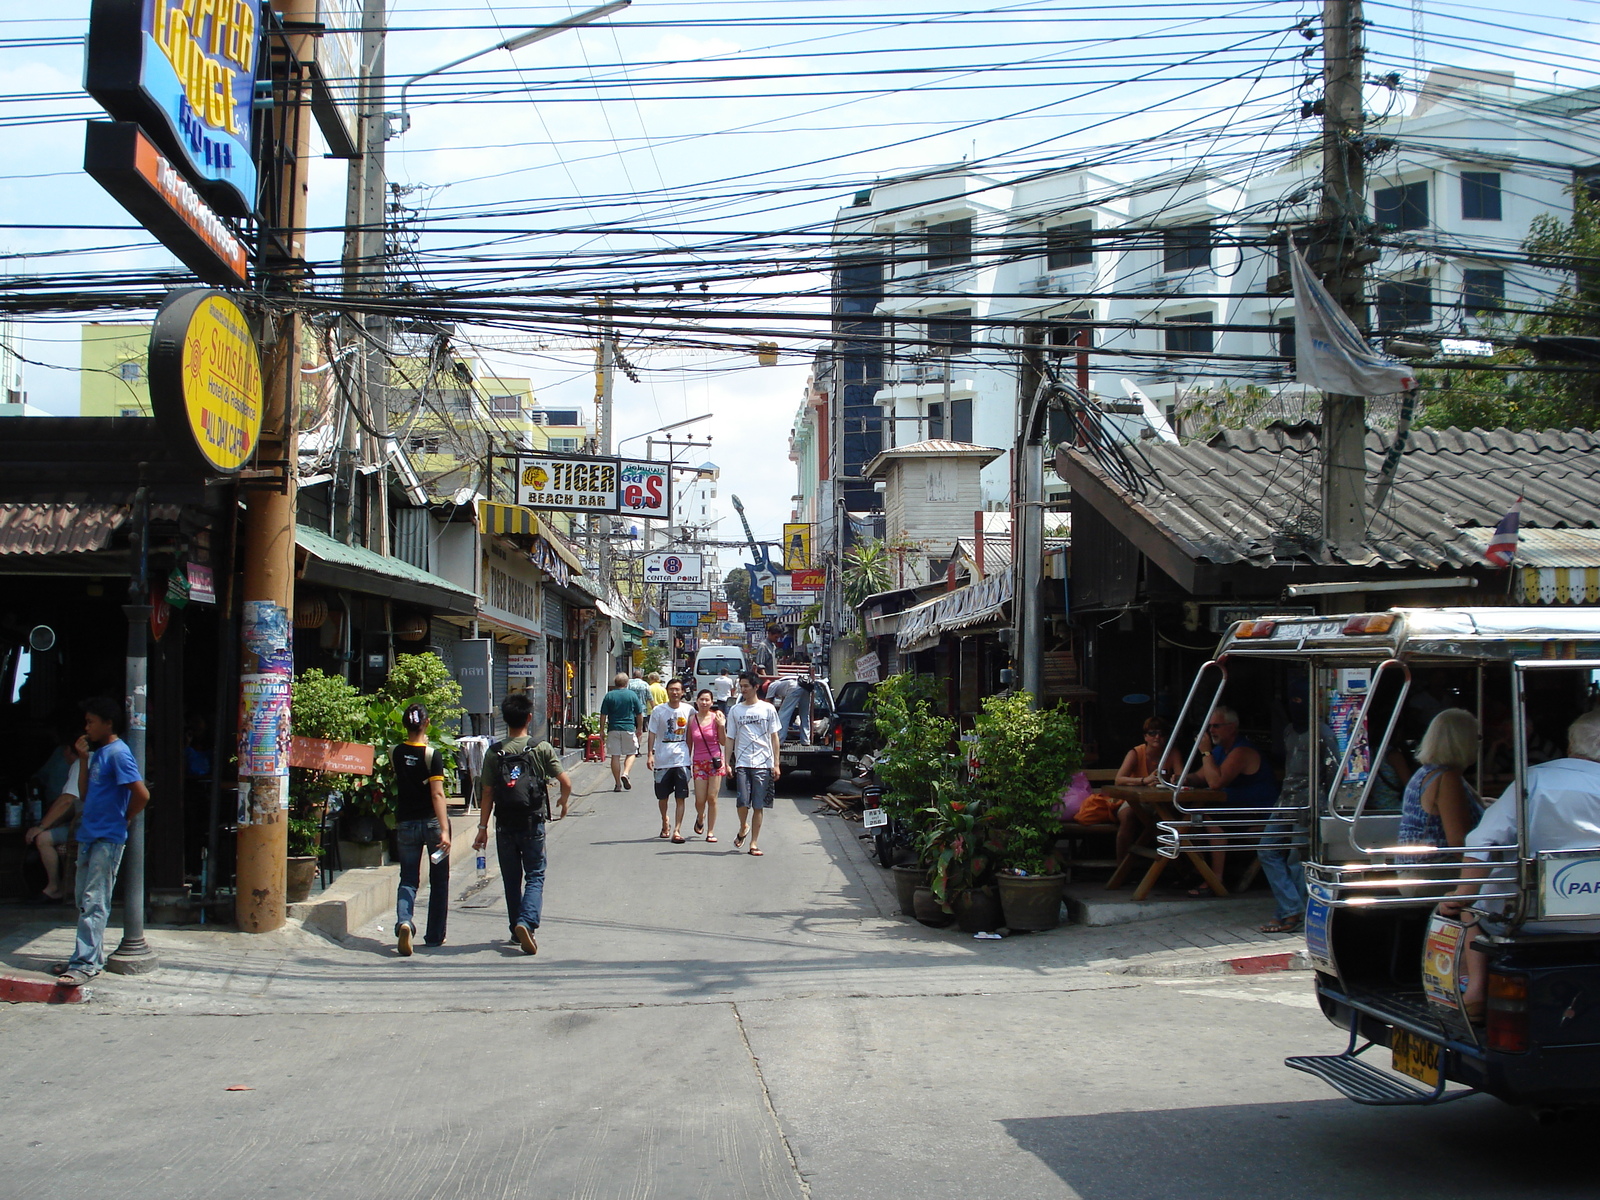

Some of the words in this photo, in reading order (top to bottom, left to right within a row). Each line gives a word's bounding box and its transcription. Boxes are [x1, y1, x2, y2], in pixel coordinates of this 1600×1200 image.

[208, 327, 259, 396] Sunshine
[207, 375, 223, 400] Hotel
[223, 385, 229, 404] &
[230, 390, 256, 421] Residence
[205, 412, 217, 443] ALL
[216, 416, 228, 451] DAY
[229, 422, 243, 459] CAFE
[551, 462, 615, 493] TIGER
[528, 492, 573, 505] BEACH
[578, 493, 606, 507] BAR
[666, 558, 679, 573] 8
[243, 685, 288, 694] MUAYTHAI
